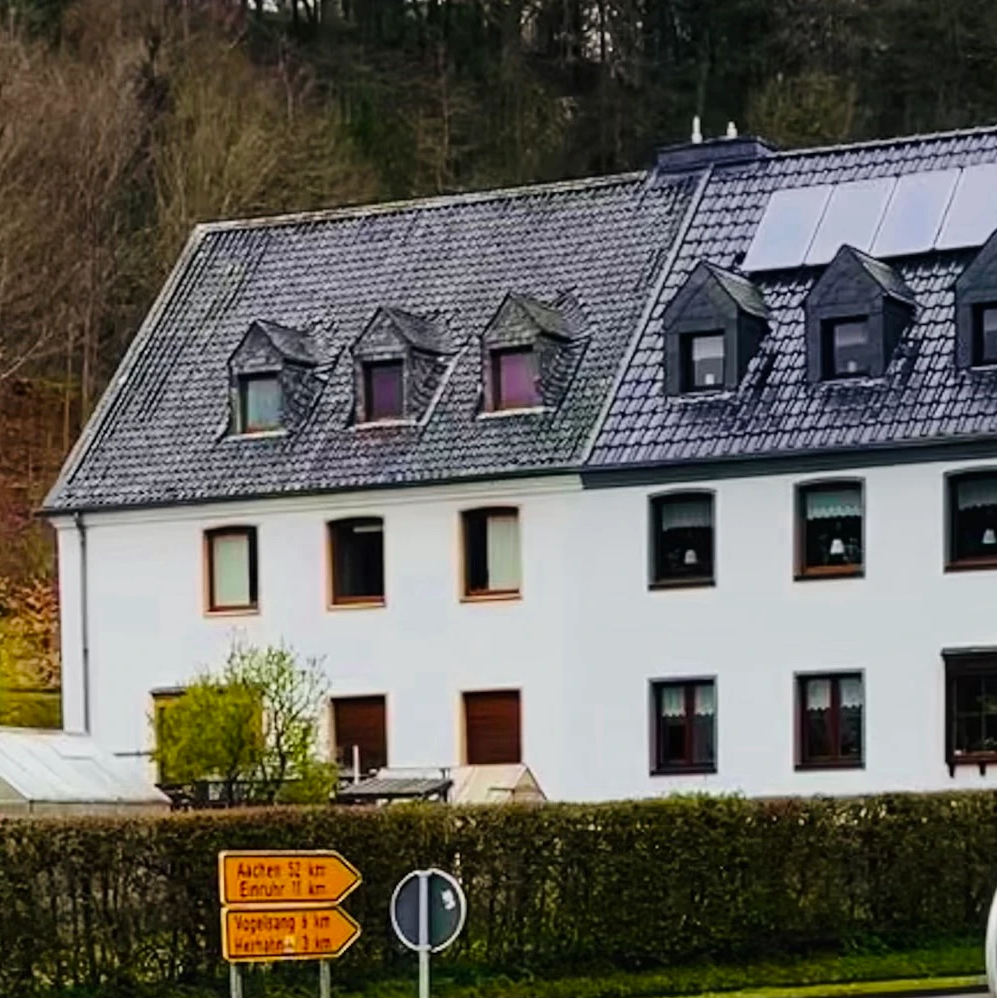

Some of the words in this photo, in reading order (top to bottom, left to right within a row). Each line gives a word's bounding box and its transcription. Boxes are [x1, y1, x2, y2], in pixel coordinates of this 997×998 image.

[237, 862, 282, 879] Aachen
[308, 862, 326, 877] km
[308, 880, 326, 895] km
[313, 913, 331, 928] km
[315, 935, 332, 950] km
